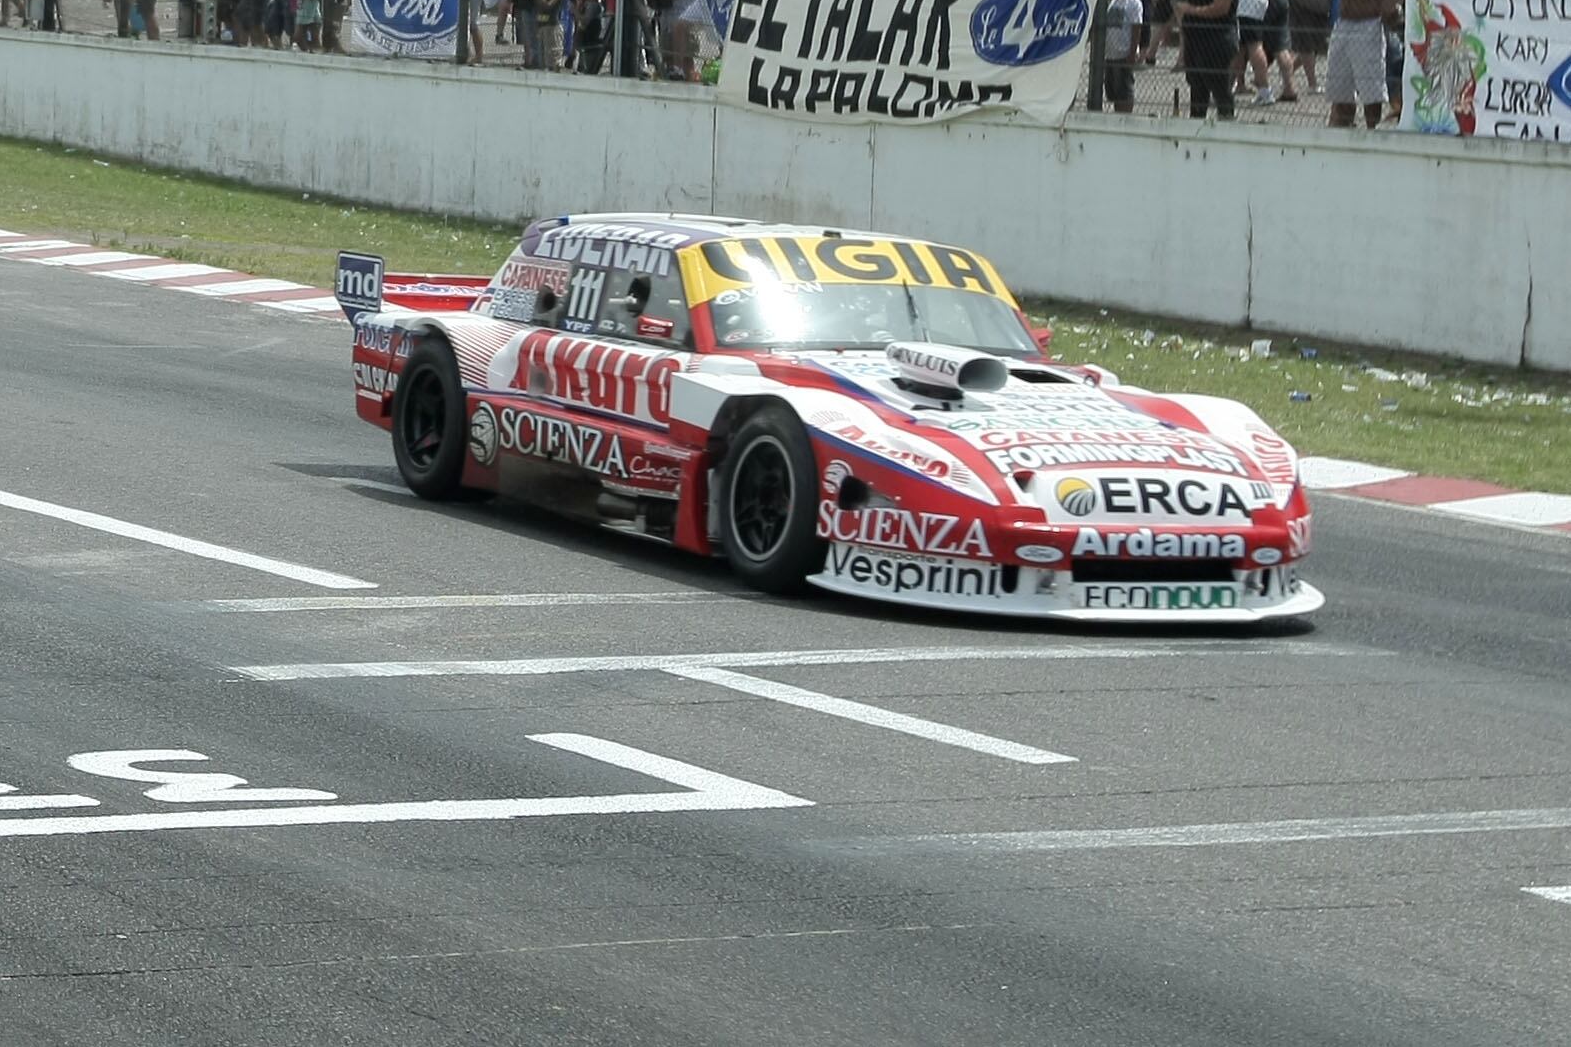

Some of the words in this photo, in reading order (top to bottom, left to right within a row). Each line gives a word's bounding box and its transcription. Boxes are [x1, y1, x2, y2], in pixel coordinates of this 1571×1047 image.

[338, 263, 379, 298] md
[568, 268, 606, 321] 111
[564, 319, 593, 333] YPF
[500, 408, 629, 478] SCIENZA
[980, 430, 1220, 449] CATANESE
[984, 442, 1250, 476] FORMINGPLAST
[1099, 477, 1256, 518] ERCA
[816, 499, 994, 557] SCIENZA
[1071, 527, 1245, 558] Ardama
[830, 542, 1002, 597] Vesprini
